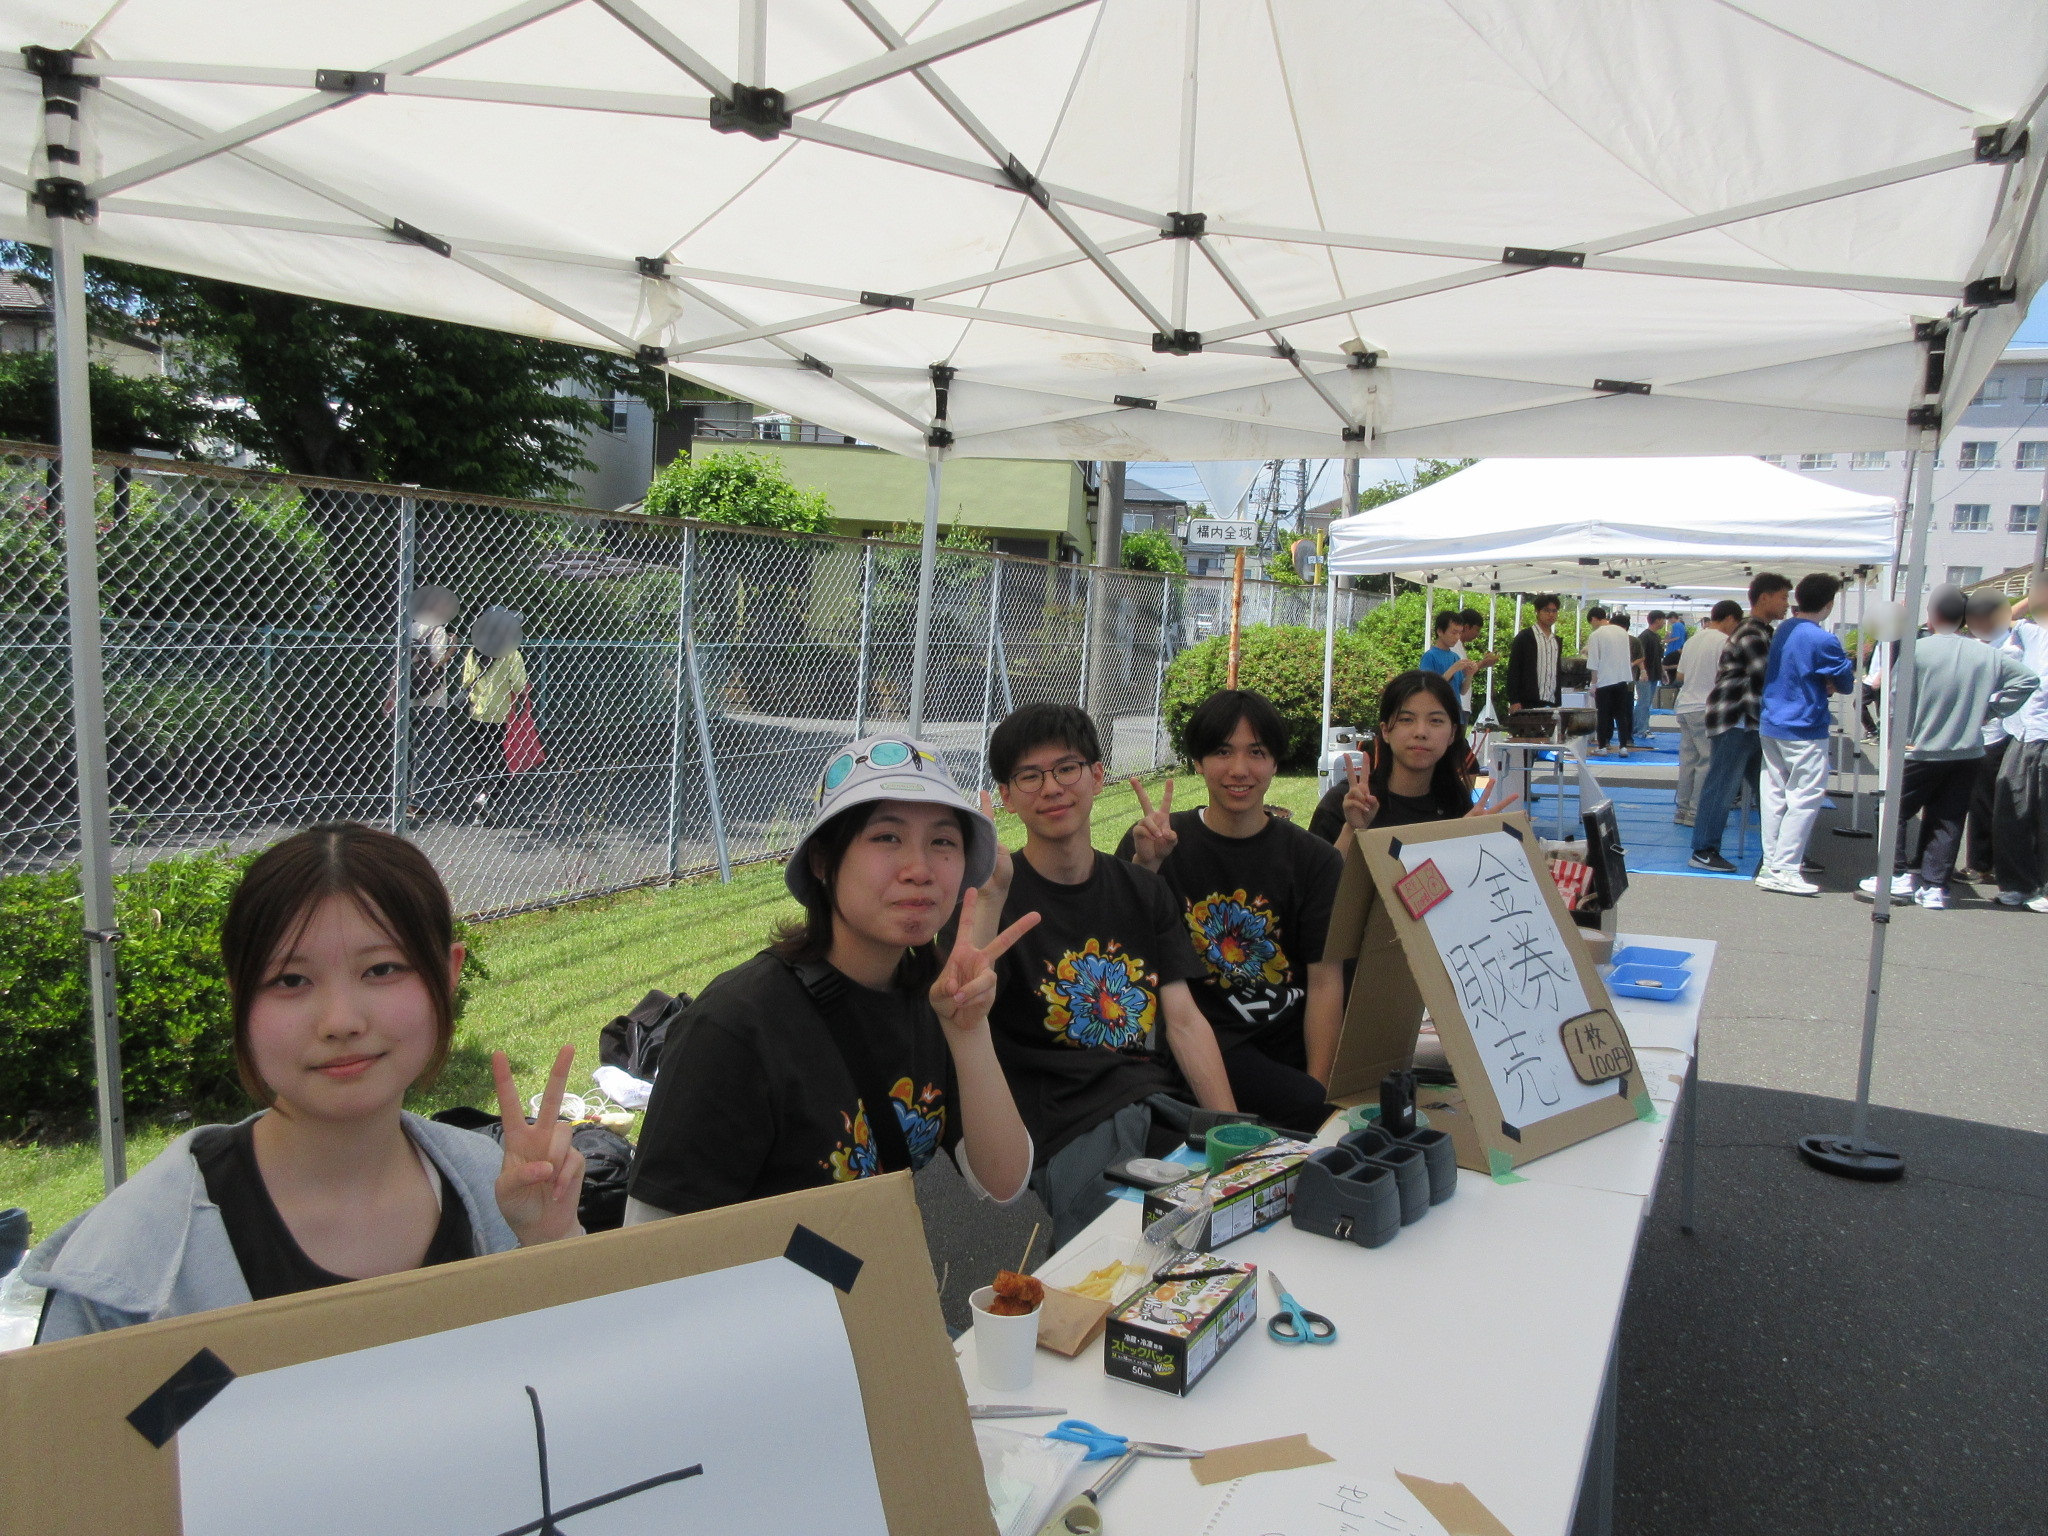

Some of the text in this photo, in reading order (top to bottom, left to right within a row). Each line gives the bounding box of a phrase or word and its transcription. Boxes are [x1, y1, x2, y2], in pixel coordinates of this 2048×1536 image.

[1196, 525, 1253, 540] 構内全域
[1467, 844, 1571, 1013] 金券
[1446, 934, 1561, 1113] 販売
[1573, 1020, 1605, 1055] 1枚
[1587, 1045, 1631, 1079] 100円
[1111, 1338, 1175, 1364] ストックバッグ
